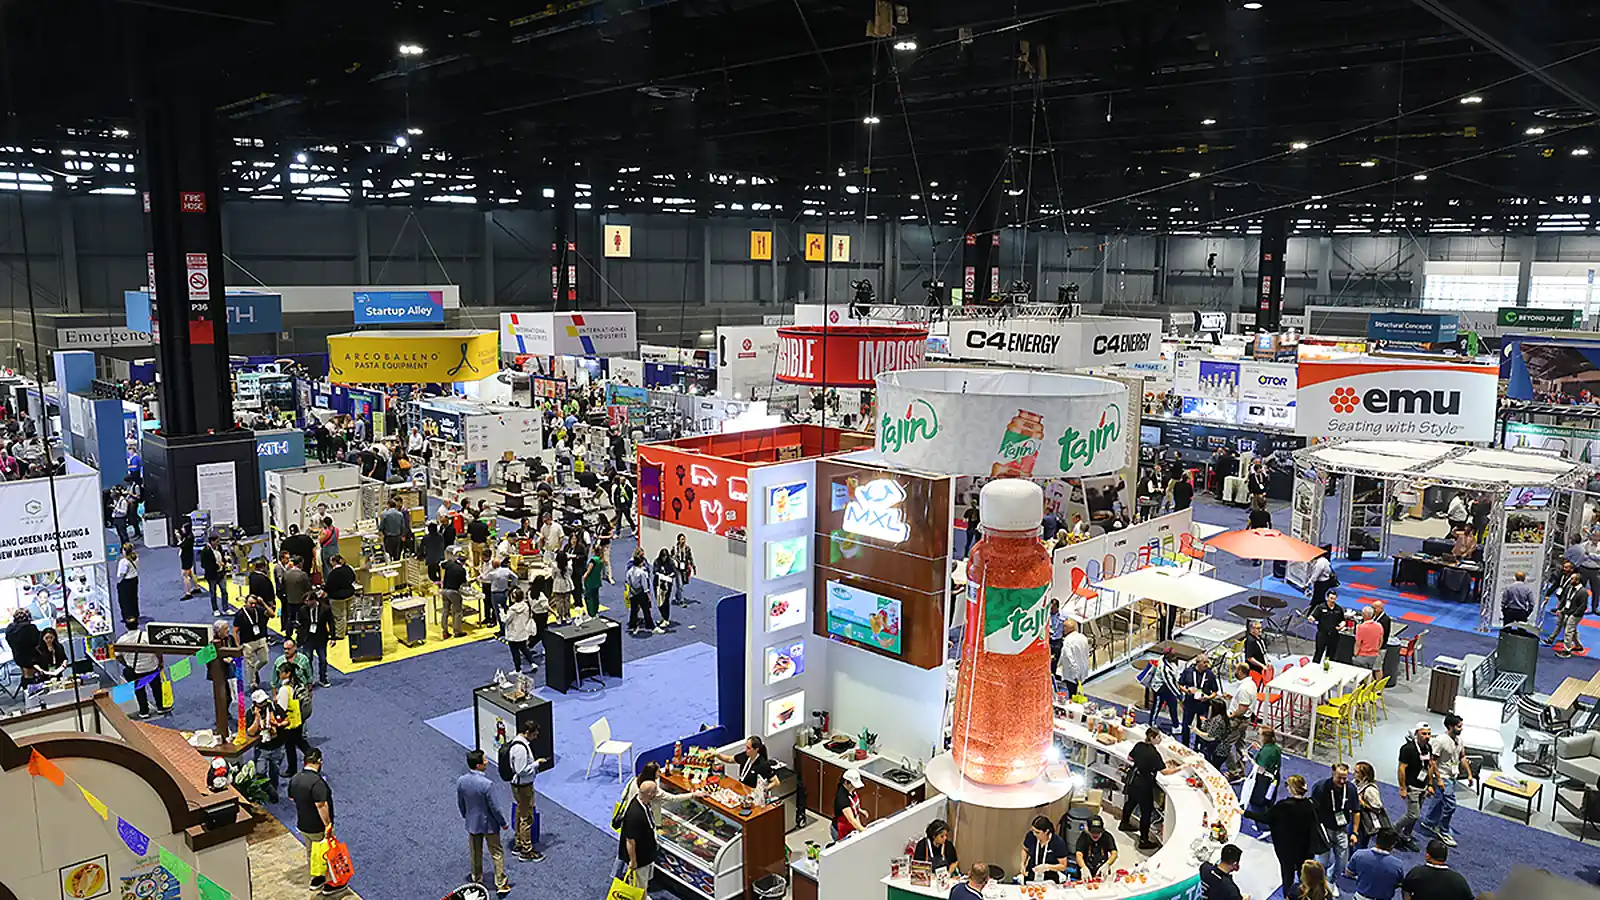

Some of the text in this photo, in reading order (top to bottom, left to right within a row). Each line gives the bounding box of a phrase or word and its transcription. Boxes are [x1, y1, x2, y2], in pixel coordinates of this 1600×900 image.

[366, 305, 433, 317] Startup Alley
[1375, 321, 1404, 329] Structural
[1404, 322, 1433, 330] Concepts
[65, 330, 154, 345] Emergency
[966, 330, 1061, 354] C4 ENERGY
[1093, 333, 1151, 355] C4 ENERGY
[345, 352, 438, 361] ARCOBALENO
[355, 361, 429, 370] PASTA EQUIPMENT
[777, 336, 815, 379] SIBLE
[857, 339, 927, 381] IMPOSS
[1363, 389, 1461, 415] emu
[1328, 419, 1383, 436] Seating
[1386, 421, 1416, 434] with
[847, 505, 901, 533] MXL
[18, 534, 43, 546] GREEN
[85, 527, 90, 536] &
[14, 545, 49, 558] MATERIAL
